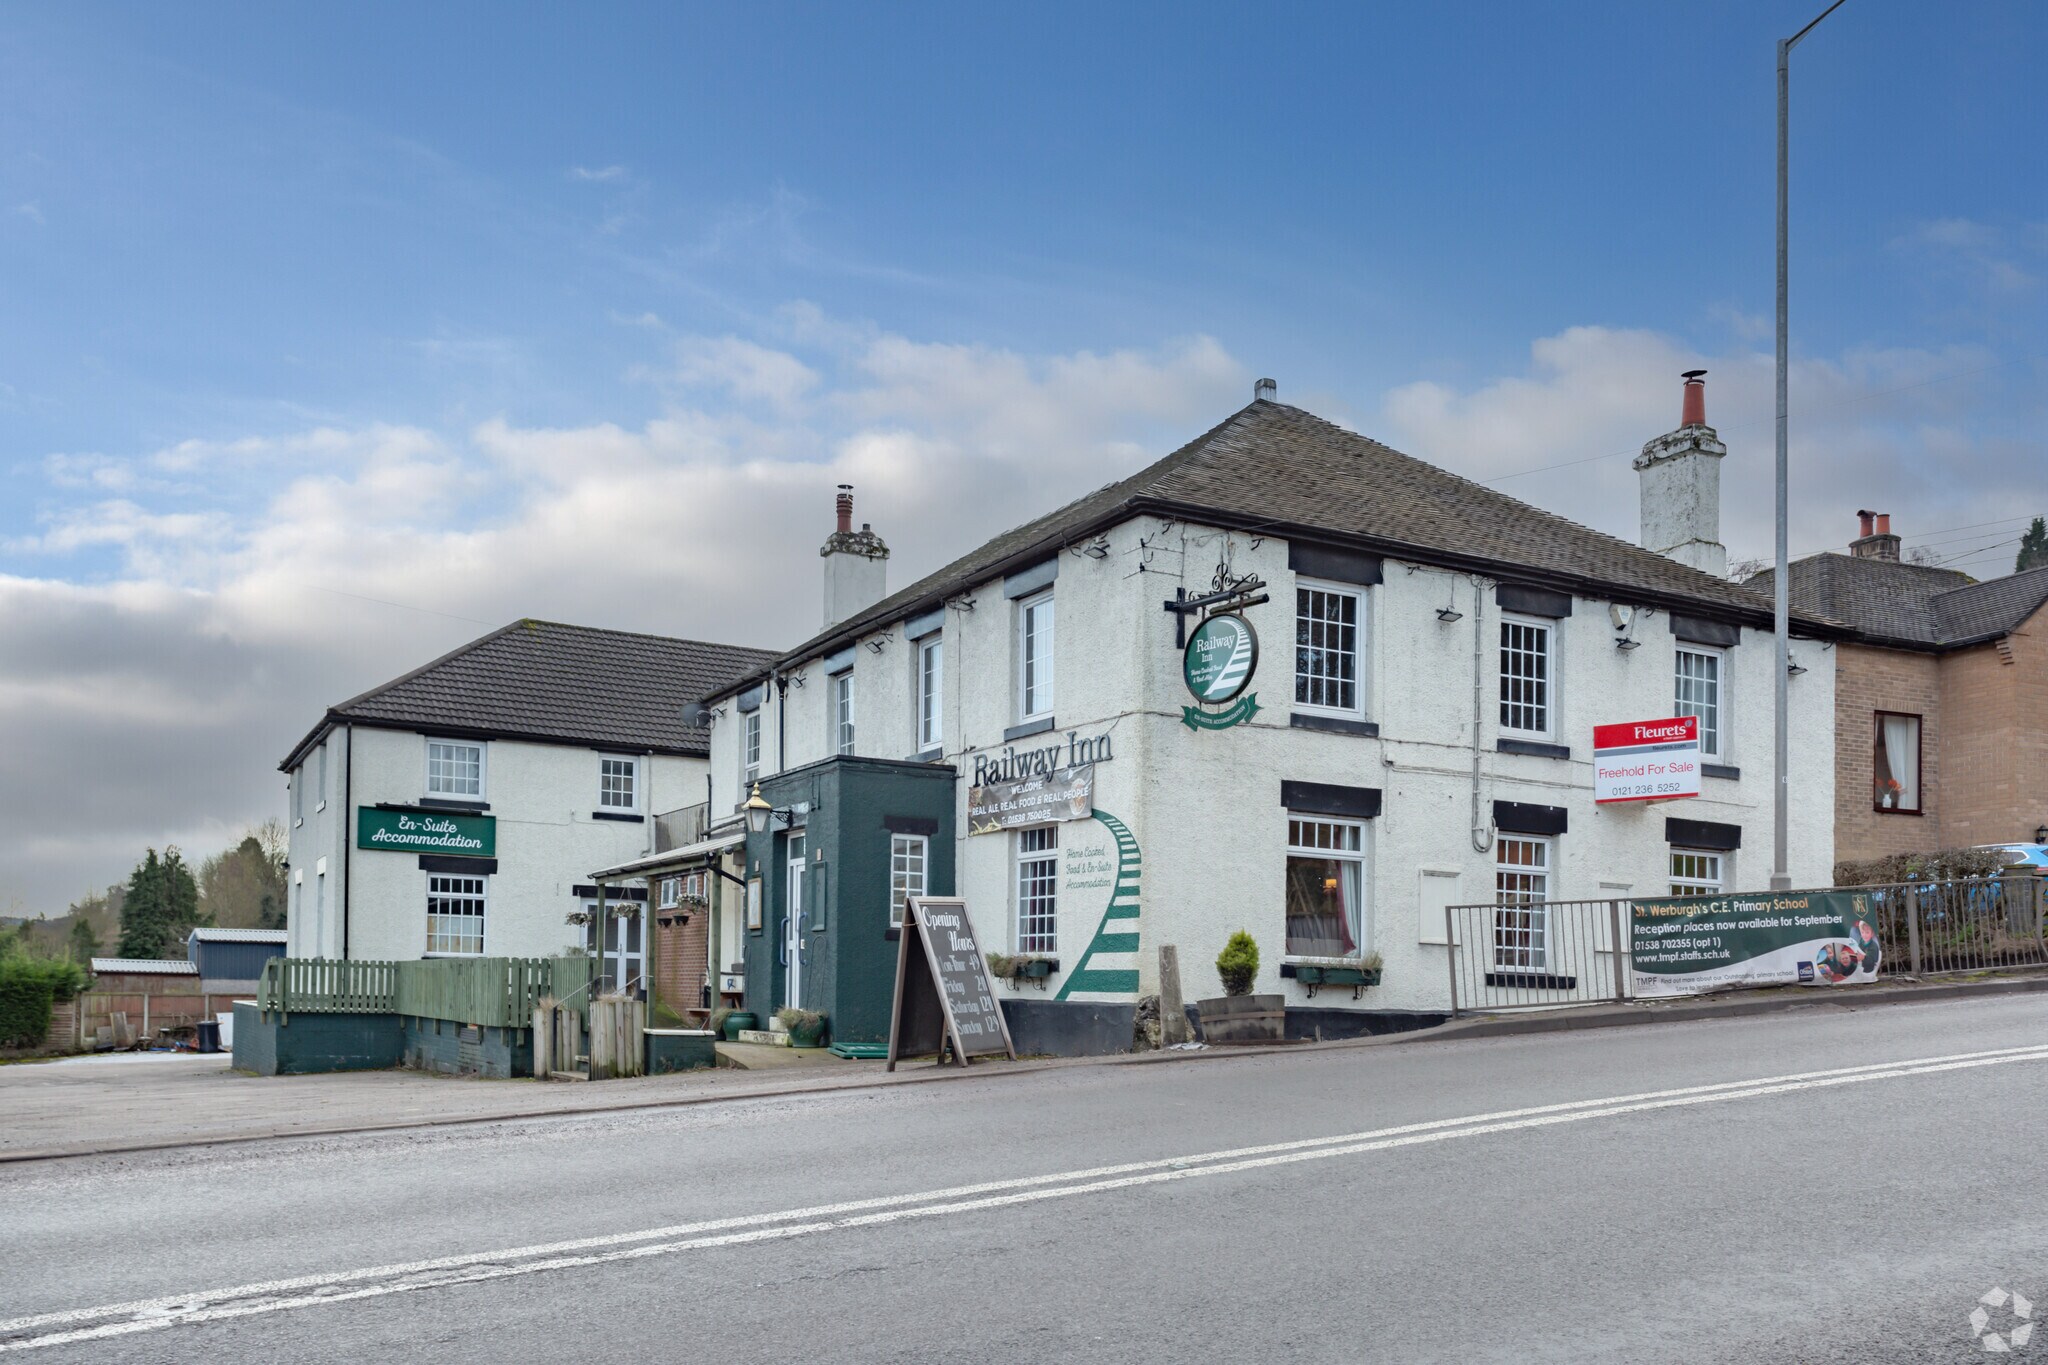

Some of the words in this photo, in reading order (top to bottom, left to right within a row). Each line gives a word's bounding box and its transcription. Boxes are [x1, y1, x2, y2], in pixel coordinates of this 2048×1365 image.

[1196, 634, 1236, 653] Railway
[1201, 653, 1213, 663] Inn
[1213, 704, 1246, 724] ACCOMMODATION
[1634, 725, 1687, 739] Fleurets
[1652, 743, 1687, 751] fleurets.com
[973, 745, 1061, 787] Railway
[1067, 731, 1113, 768] Inn
[1599, 765, 1645, 779] Freehold
[1647, 764, 1666, 775] For
[1669, 761, 1694, 773] Sale
[1011, 781, 1043, 795] WELCOME
[1612, 787, 1632, 796] 0121
[1635, 784, 1653, 795] 236
[1657, 782, 1680, 793] 5252
[972, 806, 987, 816] REAL
[1000, 801, 1018, 812] REAL
[1019, 798, 1037, 808] FOOD
[1043, 793, 1062, 804] REAL
[1063, 786, 1089, 800] PEOPLE
[398, 815, 458, 833] En-Suite
[1007, 813, 1026, 825] 01538
[1027, 809, 1051, 822] 750025
[371, 828, 482, 848] Accommodation
[1066, 848, 1083, 859] Home
[1084, 844, 1105, 858] Cooked
[1066, 863, 1080, 875] Food
[1087, 860, 1112, 873] En-Suite
[1066, 877, 1111, 889] Accommodation
[1635, 905, 1648, 918] St.
[1650, 903, 1708, 917] Werburgh's
[1710, 902, 1731, 913] C.E.
[1733, 900, 1771, 913] Primary
[1773, 897, 1809, 910] School
[922, 906, 961, 931] Opening
[1634, 922, 1682, 935] Reception
[1683, 921, 1715, 934] places
[1717, 921, 1736, 930] now
[1738, 917, 1779, 929] available
[1780, 915, 1793, 927] for
[1794, 914, 1843, 927] September
[947, 930, 975, 951] Hours
[1634, 940, 1660, 951] 01538
[1662, 938, 1692, 949] 702355
[1692, 937, 1711, 949] (opt
[1713, 936, 1721, 948] 1)
[1635, 949, 1731, 963] www.tmpf.staffs.sch.uk
[1636, 976, 1658, 986] TMPF
[1696, 974, 1712, 982] about
[1756, 971, 1776, 979] primary
[942, 976, 965, 995] Friday
[948, 998, 980, 1015] Saturday
[955, 1018, 983, 1035] Sunday
